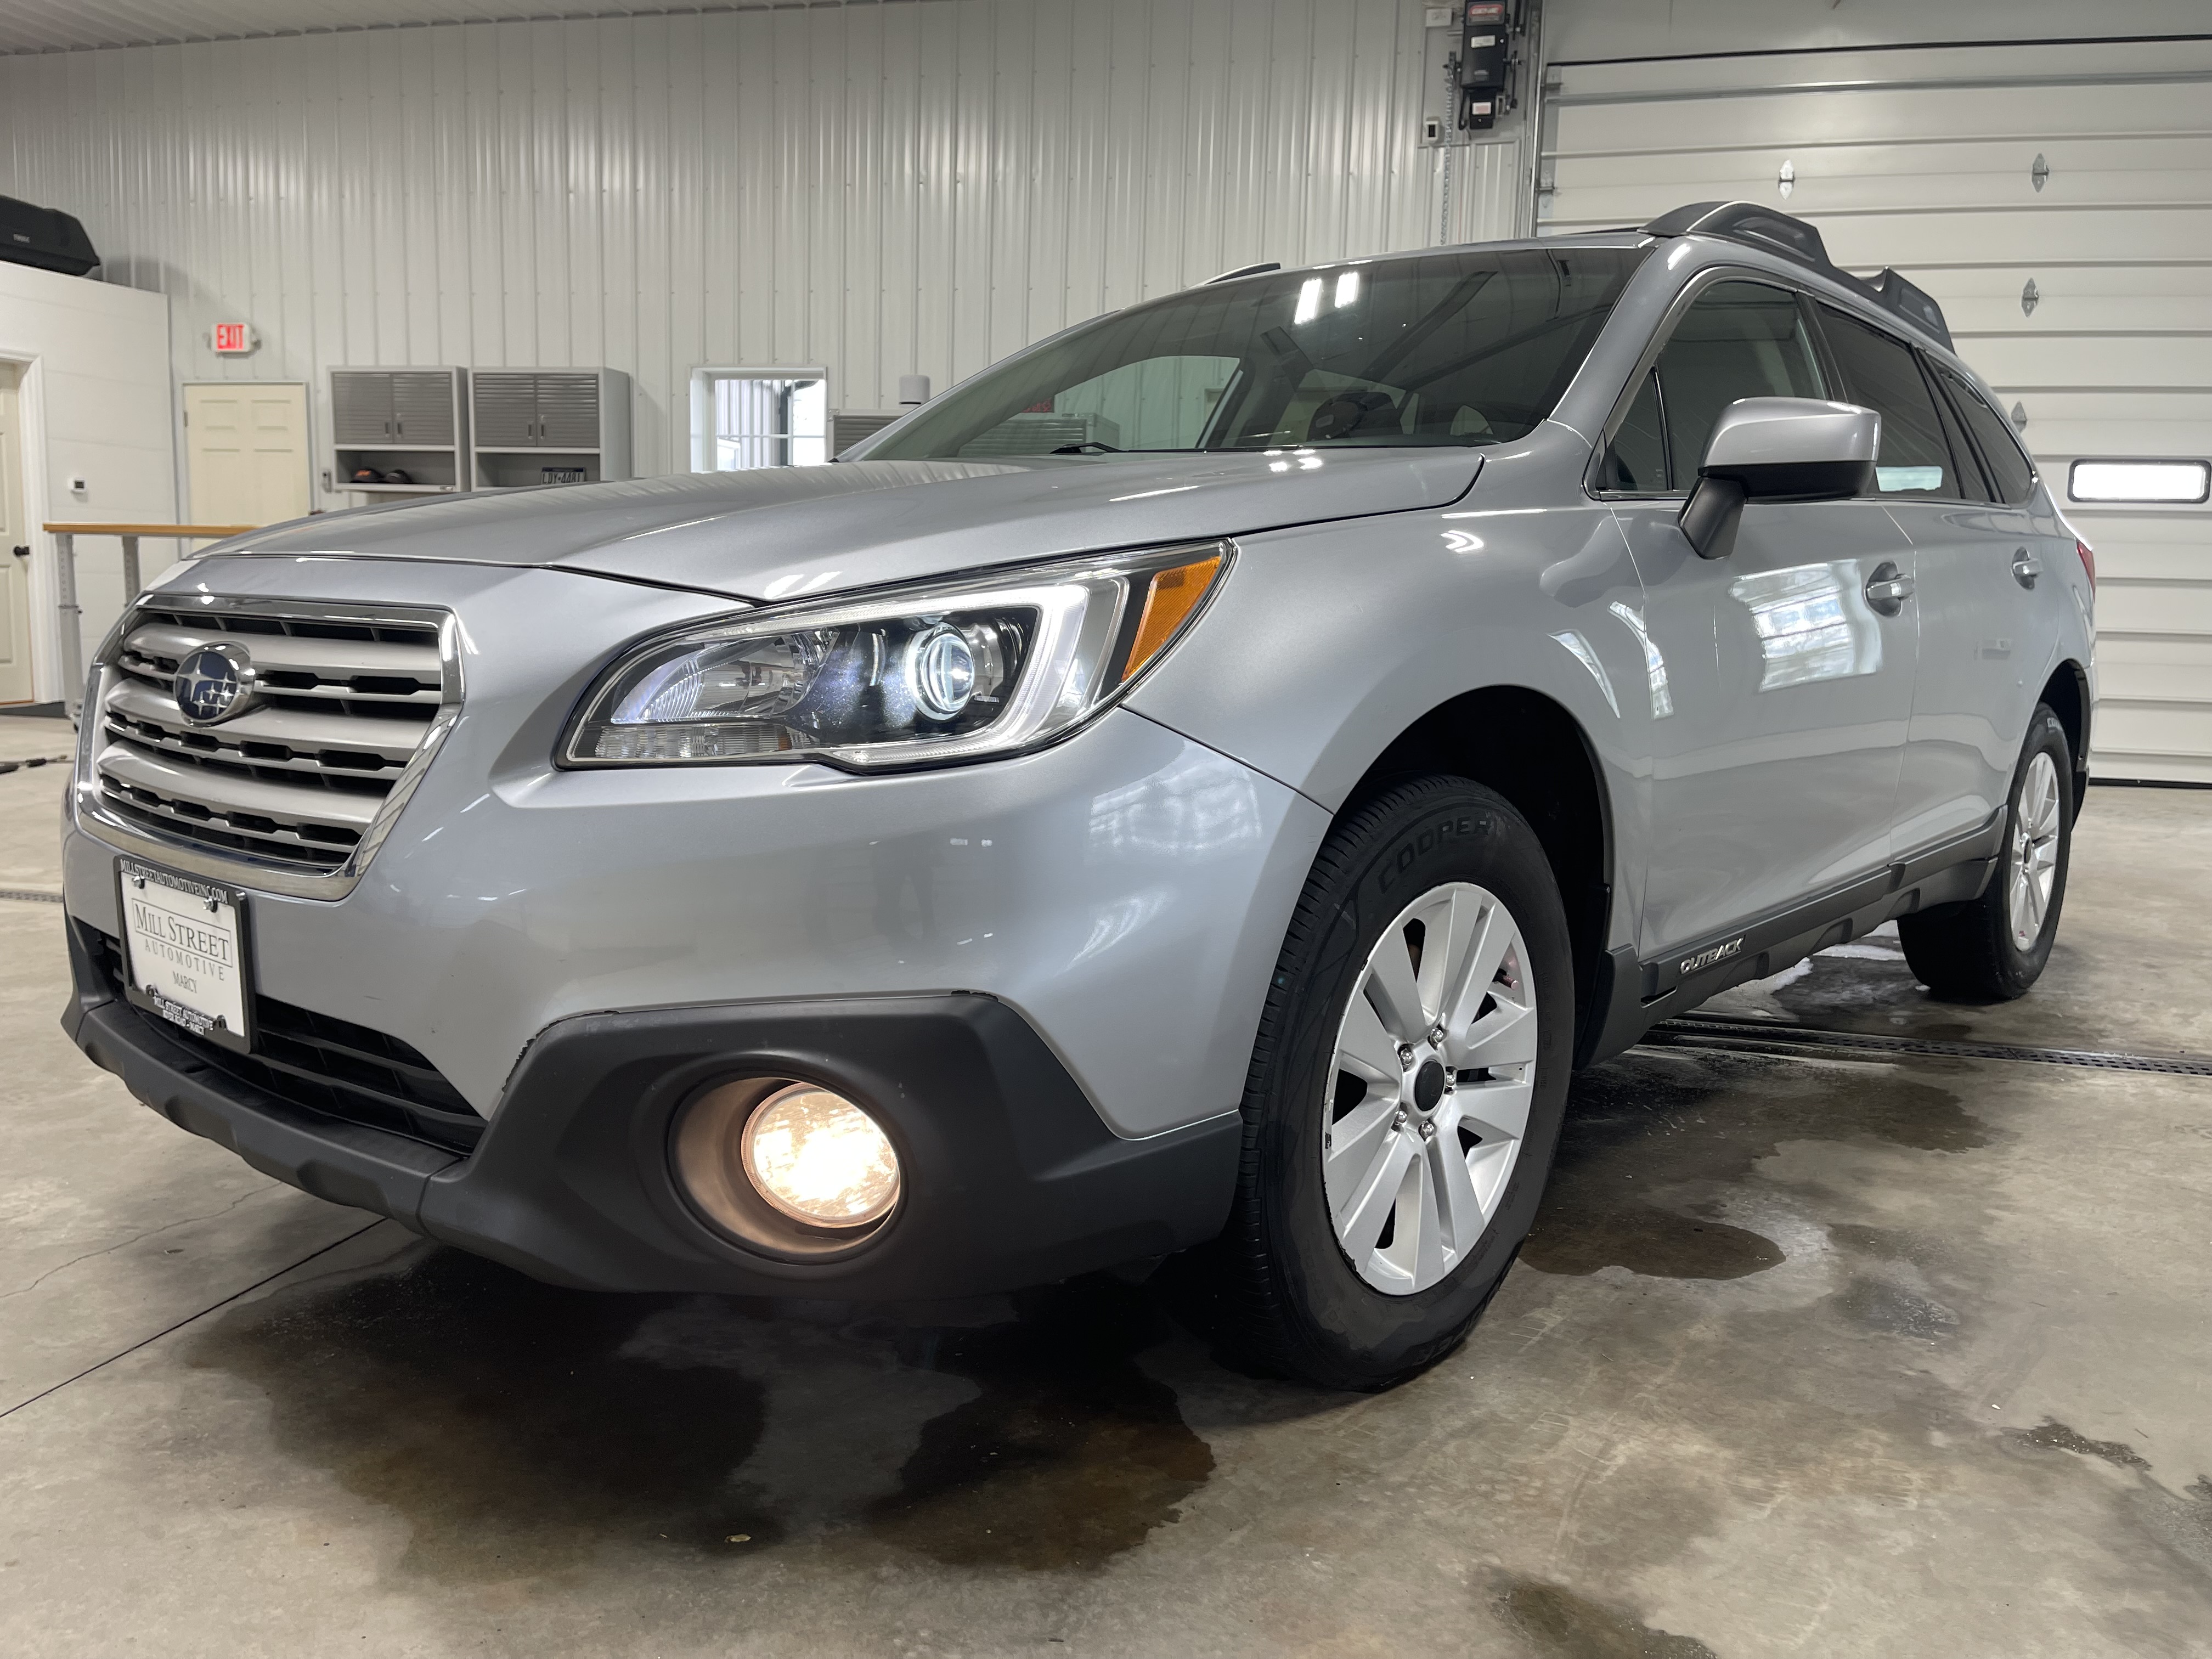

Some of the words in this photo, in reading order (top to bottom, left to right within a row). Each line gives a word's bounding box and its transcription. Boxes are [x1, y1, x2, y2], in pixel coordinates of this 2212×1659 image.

[217, 324, 244, 350] EXIT
[1378, 816, 1493, 895] COOPER
[145, 939, 224, 981] AUTOMOTIVE
[1680, 937, 1743, 974] OUTBACK
[173, 970, 197, 994] MARCY
